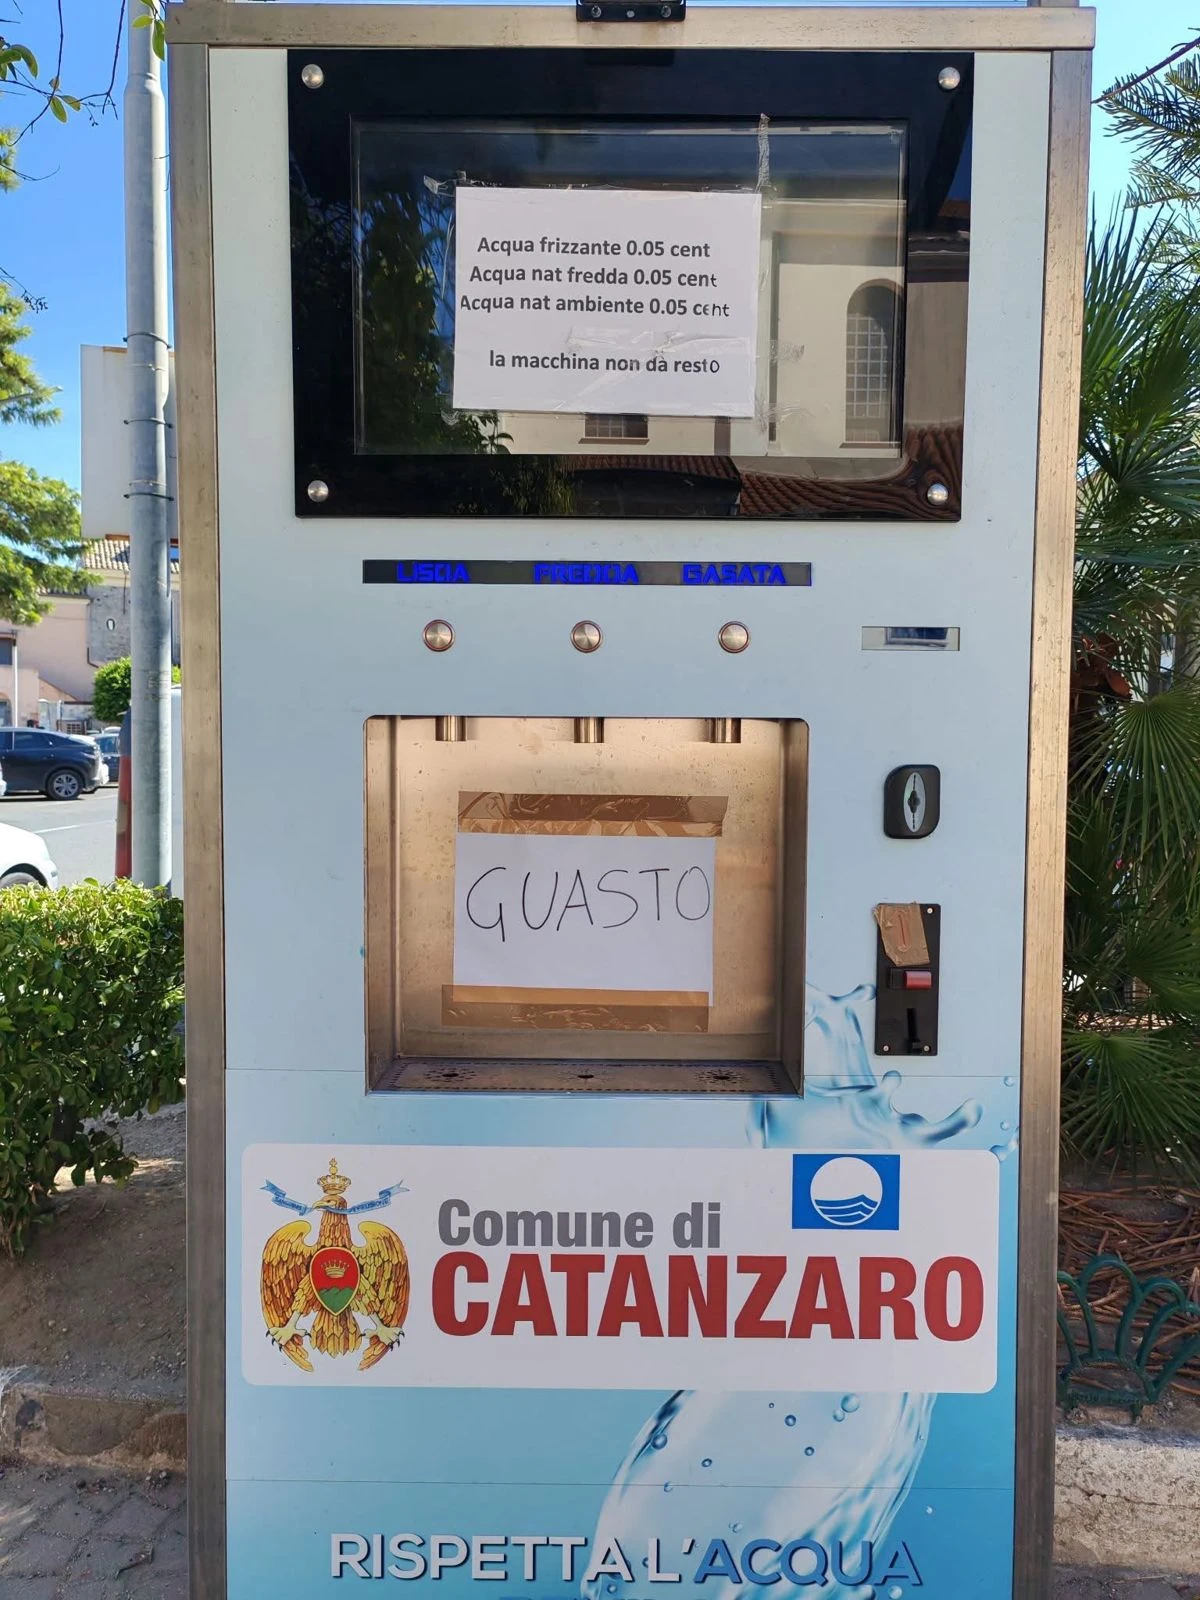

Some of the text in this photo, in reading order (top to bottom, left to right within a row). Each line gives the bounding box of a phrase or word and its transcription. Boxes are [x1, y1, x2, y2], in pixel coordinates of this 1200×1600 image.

[477, 236, 711, 258] Acqua frizzante 0.05 cent
[469, 266, 718, 288] Acqua nat fredda 0.05 cent
[460, 295, 514, 313] Acqua
[520, 295, 551, 311] nat
[556, 295, 644, 313] ambiente
[649, 298, 688, 315] 0.05
[489, 350, 506, 367] la
[511, 352, 600, 371] macchina
[605, 357, 640, 371] non
[674, 358, 720, 373] resto
[682, 563, 787, 585] GASATA
[466, 866, 711, 943] GUASTO
[438, 1199, 721, 1249] Comune di
[431, 1251, 985, 1342] CATANZARO
[331, 1533, 923, 1587] RISPETTA L'ACQUA
